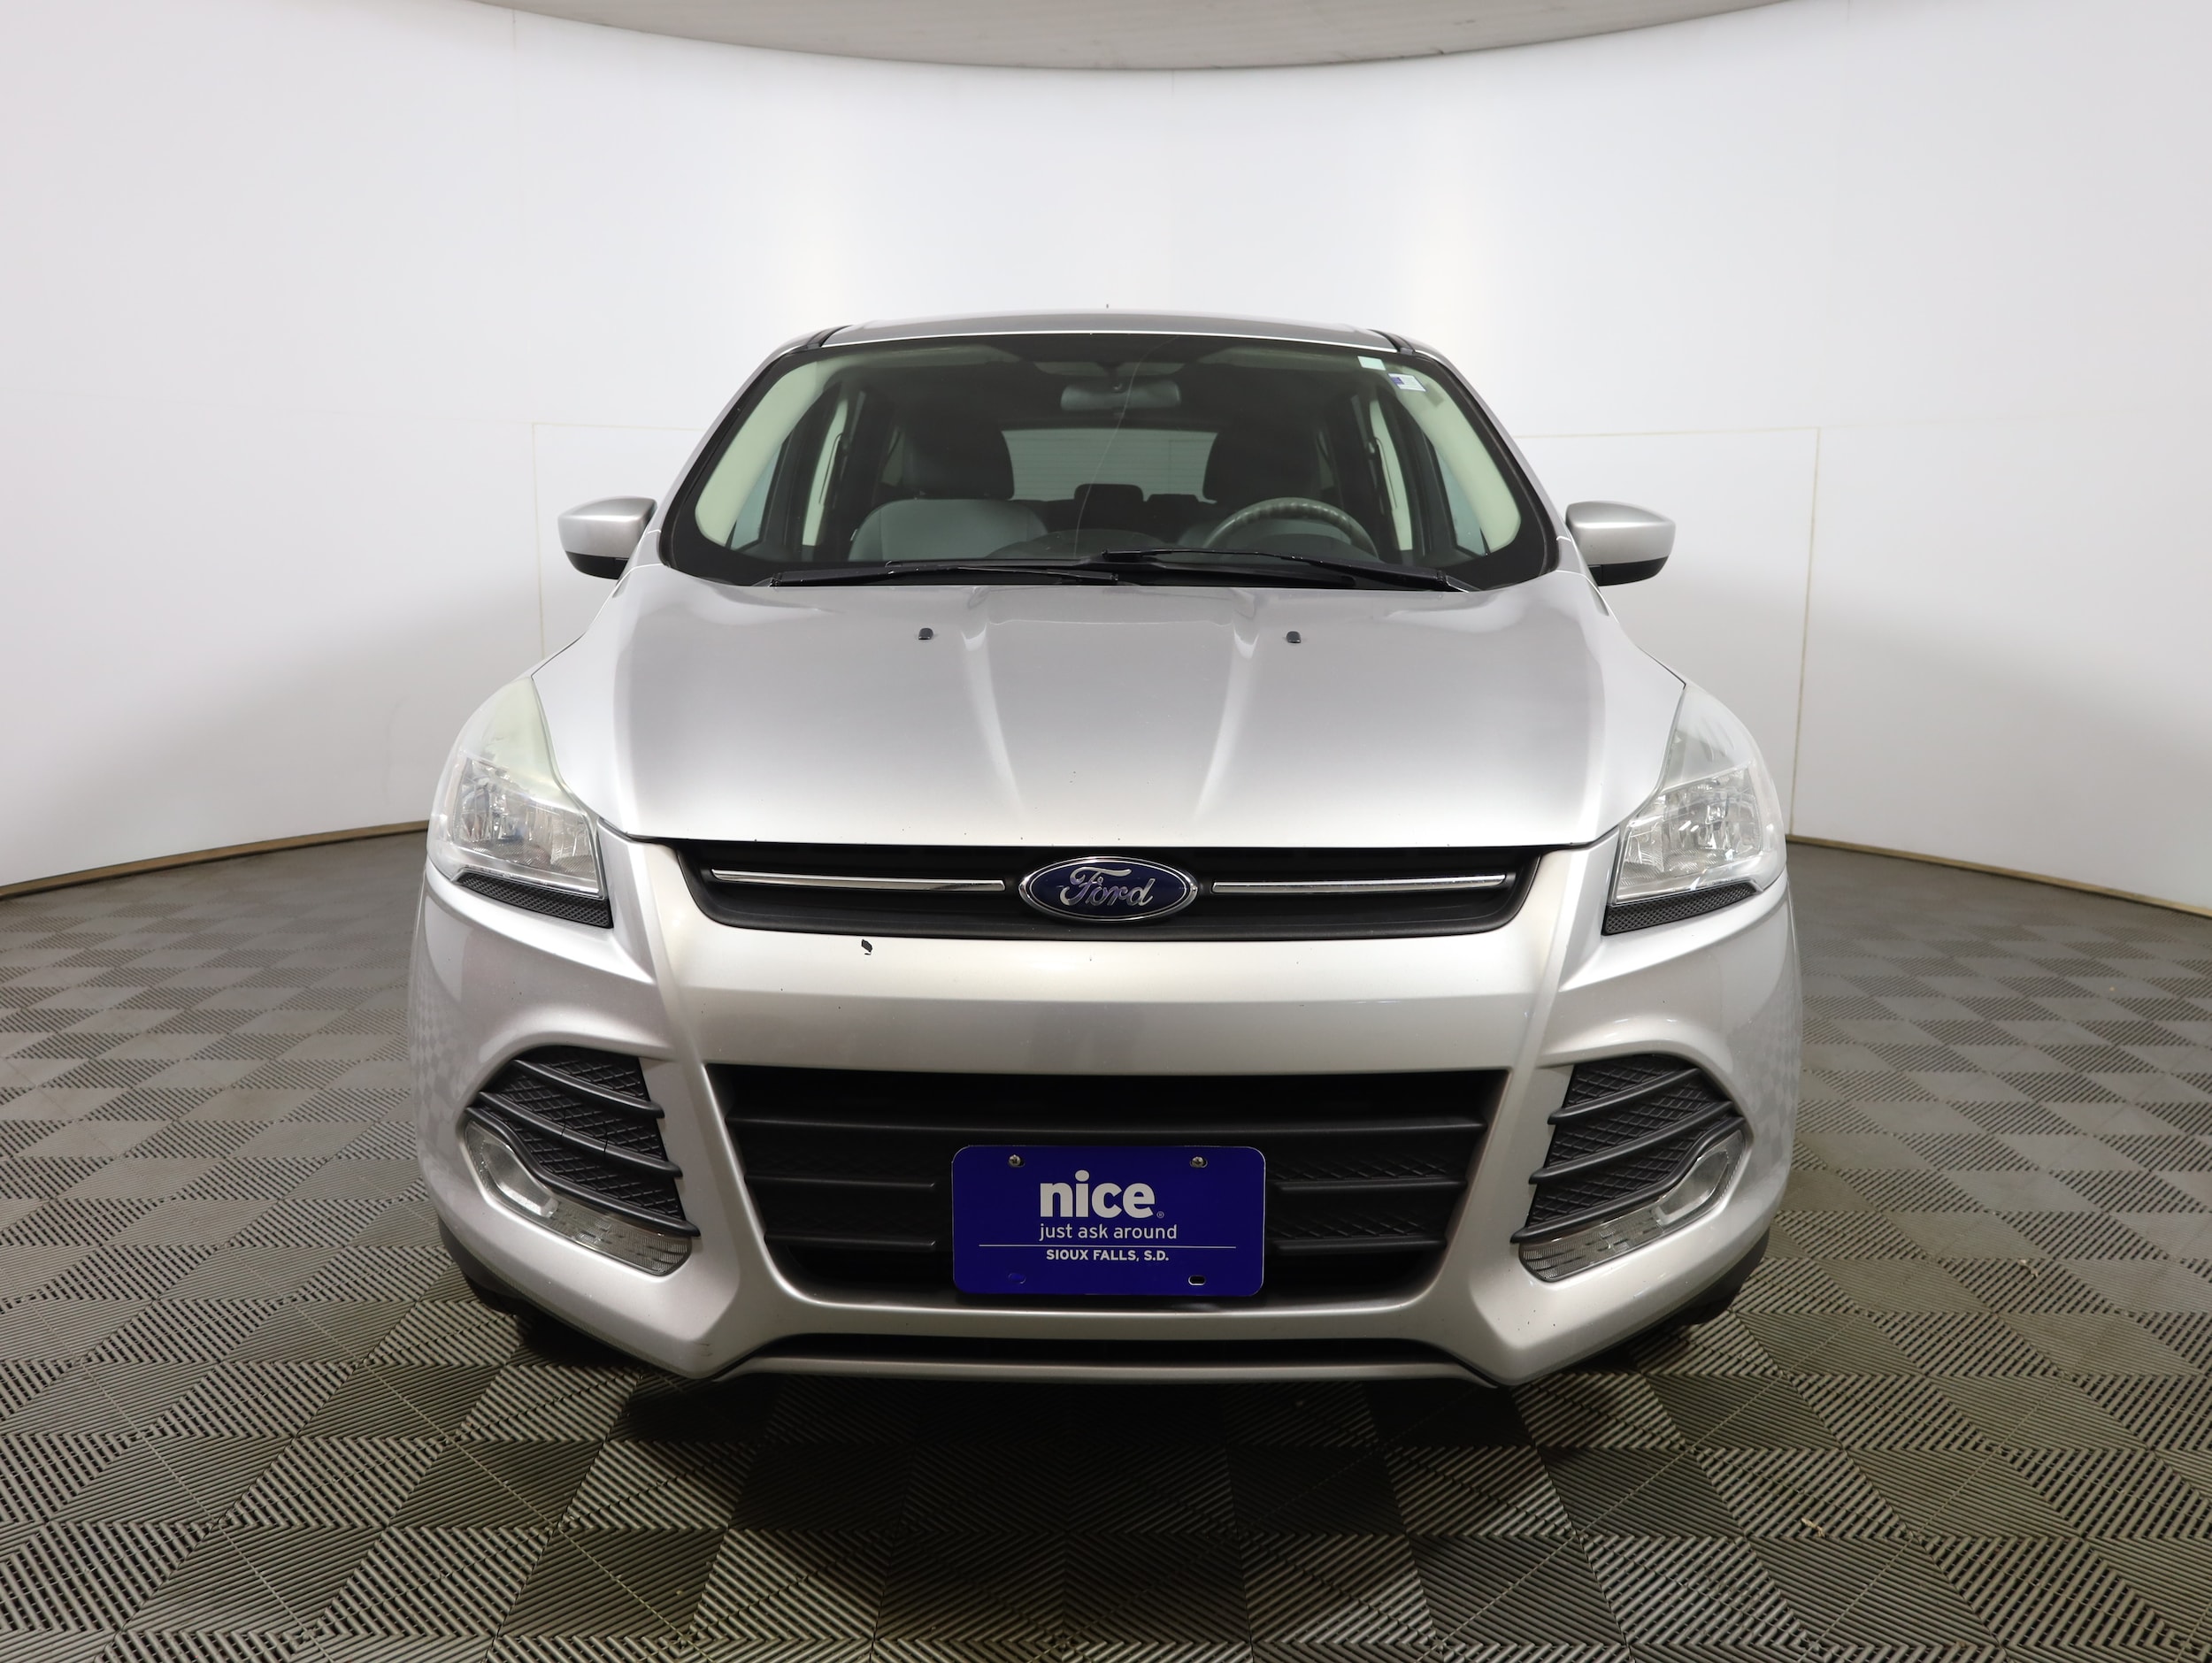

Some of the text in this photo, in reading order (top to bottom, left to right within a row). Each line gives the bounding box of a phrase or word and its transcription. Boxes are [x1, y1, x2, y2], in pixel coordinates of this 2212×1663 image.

[1056, 866, 1156, 907] Ford
[1039, 1222, 1177, 1242] just ask around
[1046, 1249, 1170, 1262] SIOUX FALLS, S.D.
